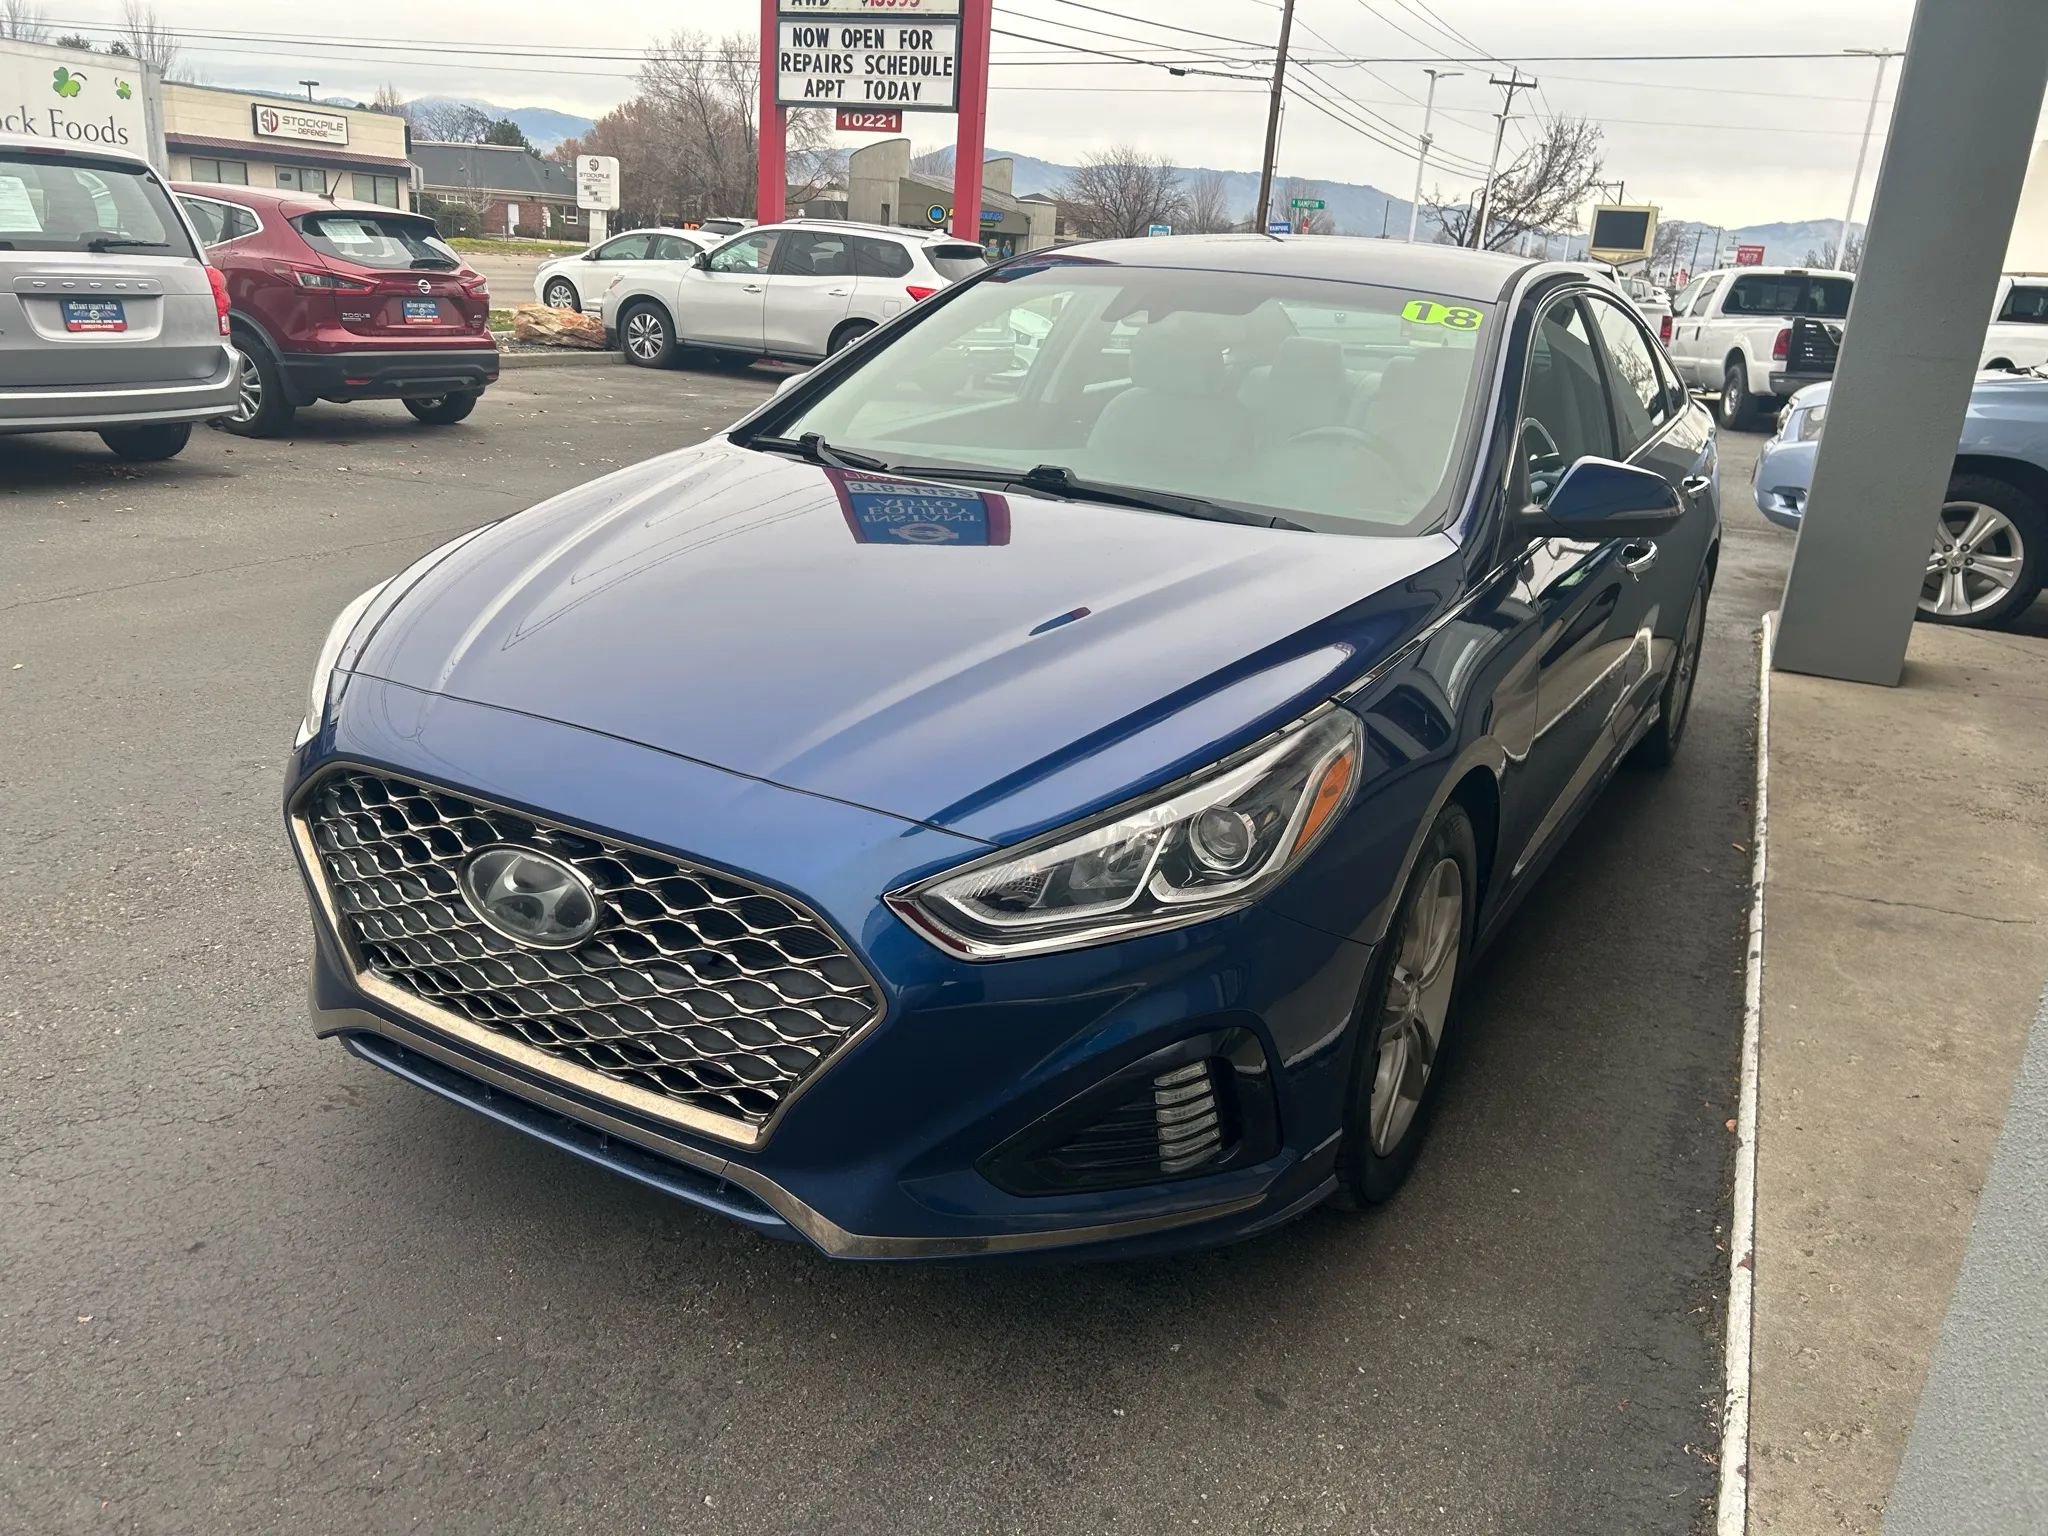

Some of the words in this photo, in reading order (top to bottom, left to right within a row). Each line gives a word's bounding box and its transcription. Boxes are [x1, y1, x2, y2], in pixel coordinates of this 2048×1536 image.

[792, 27, 829, 48] NOW
[841, 28, 884, 49] OPEN
[900, 29, 933, 50] FOR
[781, 53, 853, 74] REPAIRS
[864, 55, 952, 77] SCHEDULE
[804, 79, 845, 98] APPT
[864, 80, 921, 101] TODAY
[0, 105, 38, 135] ck
[48, 108, 128, 145] Foods
[282, 116, 344, 131] STOCKPILE
[842, 113, 897, 128] 10221
[298, 128, 328, 137] DEFENSE
[1413, 302, 1477, 329] 18
